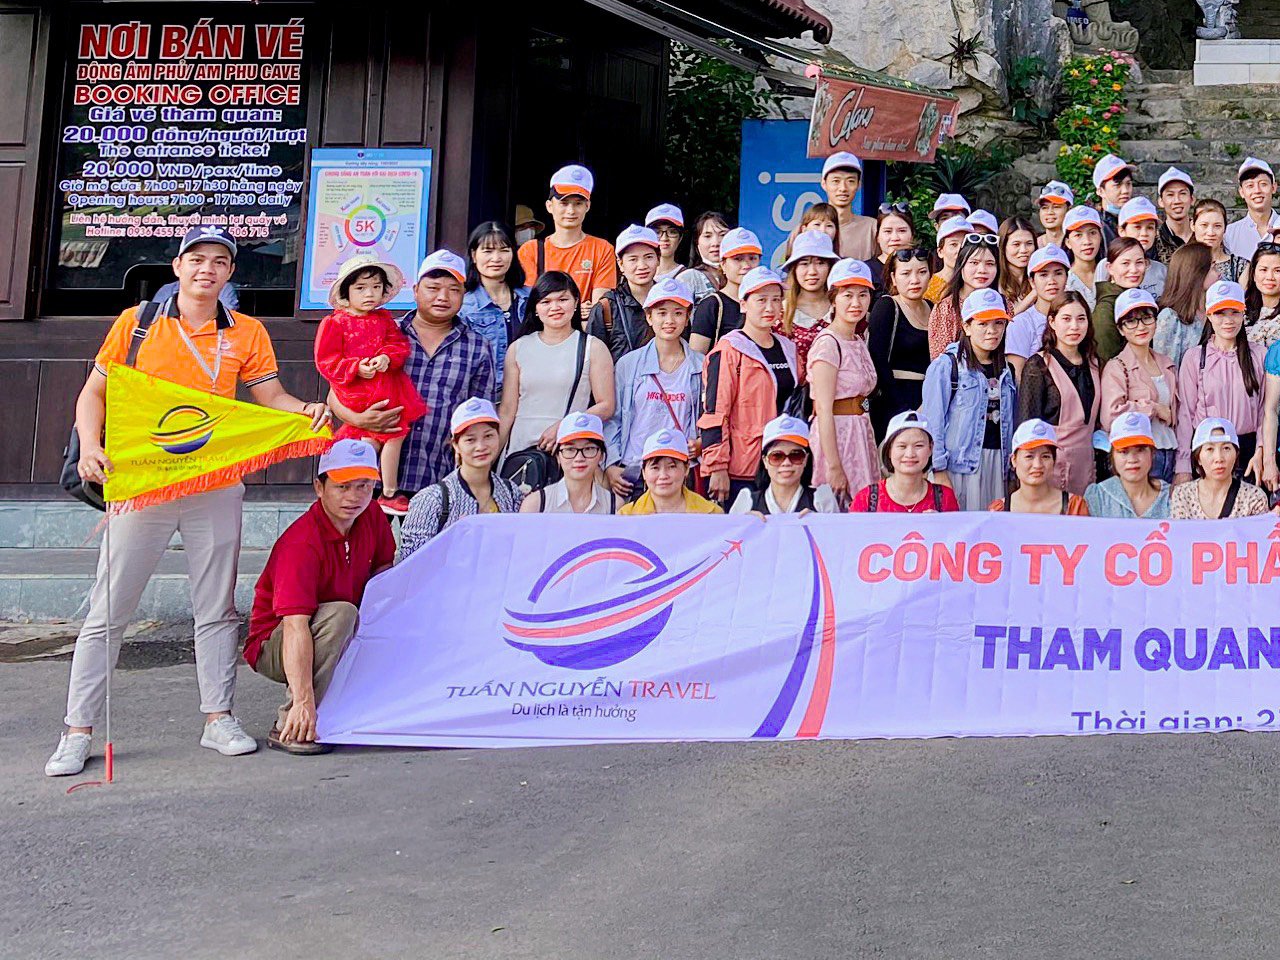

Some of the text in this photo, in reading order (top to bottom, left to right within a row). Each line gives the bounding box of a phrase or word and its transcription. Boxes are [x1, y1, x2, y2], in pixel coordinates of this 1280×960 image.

[78, 18, 305, 59] NƠI BÁN VÉ
[77, 61, 122, 83] ĐỘNG
[124, 61, 152, 80] ÂM
[194, 64, 222, 80] AM
[224, 64, 258, 80] PHU
[261, 64, 300, 80] CAVE
[74, 84, 300, 105] BOOKING OFFICE
[89, 106, 283, 124] Giá vé tham quan:
[63, 126, 147, 143] 20.000
[98, 143, 270, 157] The entrance ticket
[82, 161, 282, 179] 20.000 VND/pax/time
[267, 179, 303, 193] ngày
[68, 194, 126, 208] Opening
[128, 195, 169, 205] hours:
[257, 194, 292, 207] daily
[86, 226, 126, 236] Hotline:
[126, 226, 154, 237] 0936
[153, 226, 174, 237] 455
[355, 220, 375, 233] 5K
[857, 531, 1002, 583] CÔNG
[1020, 544, 1089, 586] TY
[1104, 522, 1174, 586] CỔ
[974, 625, 1121, 671] THAM
[517, 676, 622, 699] NGUYỄN
[628, 680, 716, 700] TRAVEL
[511, 702, 637, 723] Du lịch là tận hưởng
[1071, 710, 1146, 731] Thời
